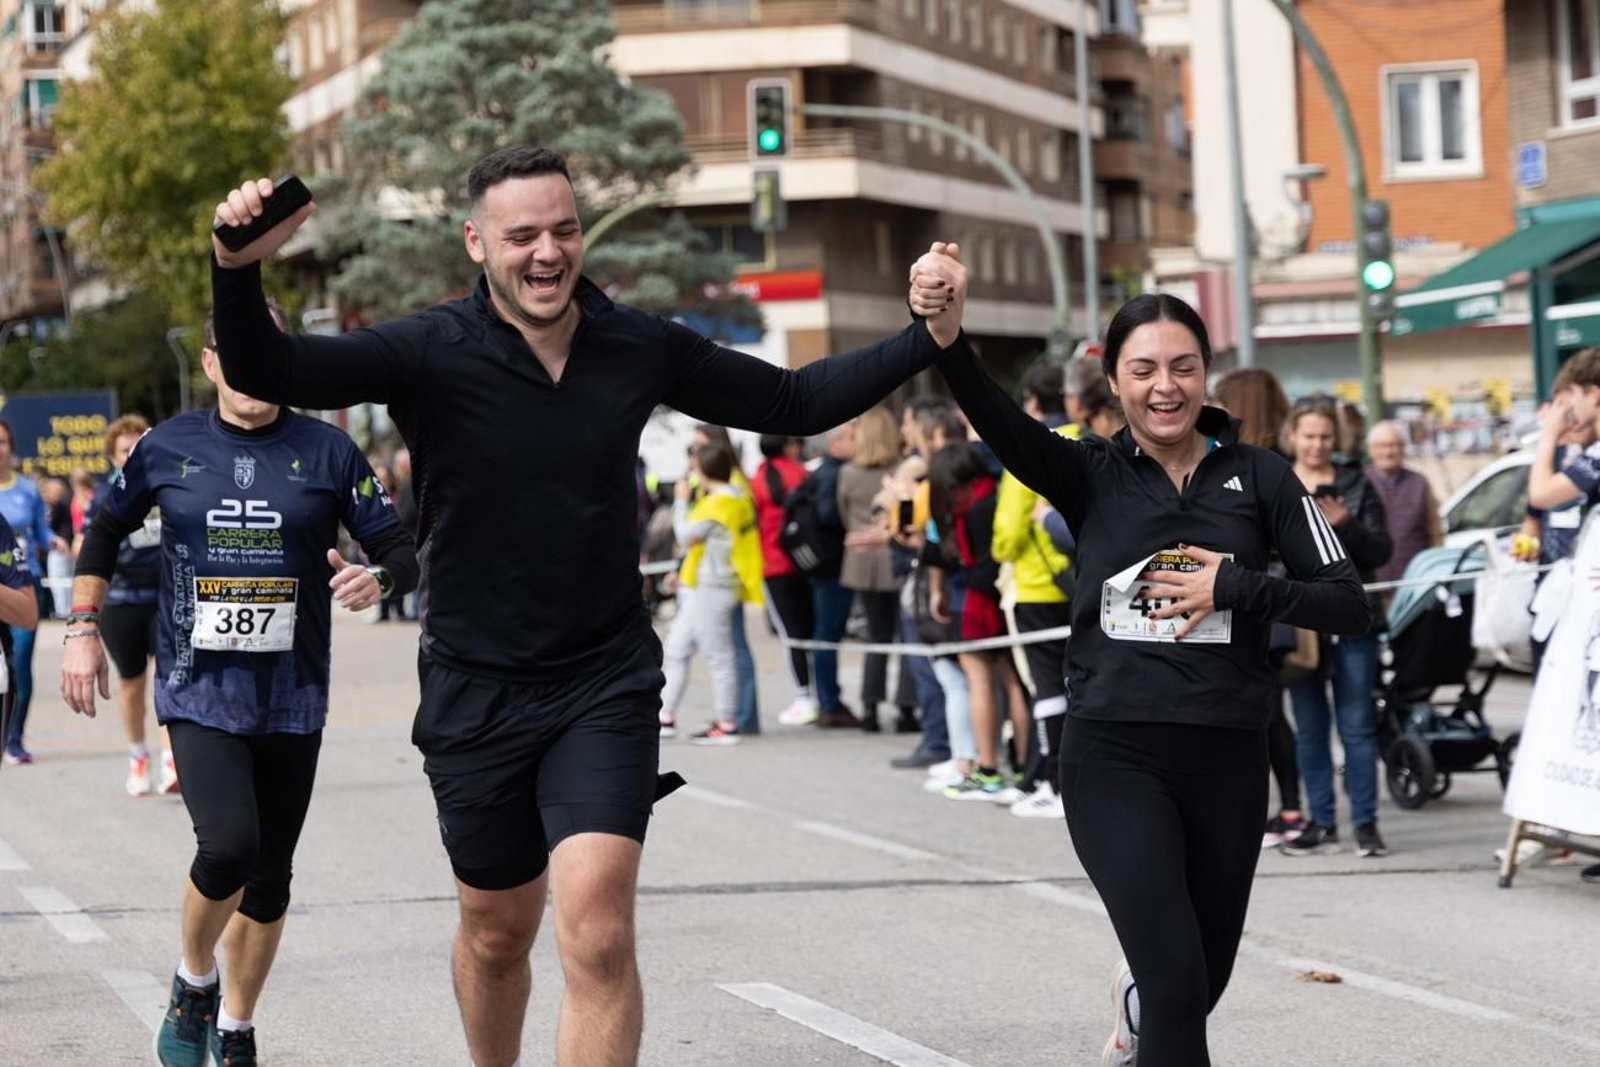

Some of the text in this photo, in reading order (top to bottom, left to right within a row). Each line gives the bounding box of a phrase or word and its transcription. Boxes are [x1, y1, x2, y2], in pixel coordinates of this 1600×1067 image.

[50, 414, 107, 434] TODO
[37, 435, 106, 455] LO QUE
[206, 498, 283, 530] 25
[206, 528, 282, 539] CARRERA
[208, 537, 284, 549] POPULAR
[217, 547, 239, 555] gran
[1150, 563, 1175, 571] gran
[175, 562, 186, 625] CATALINA
[199, 580, 221, 594] XXV
[231, 587, 252, 595] gran
[214, 607, 277, 635] 387
